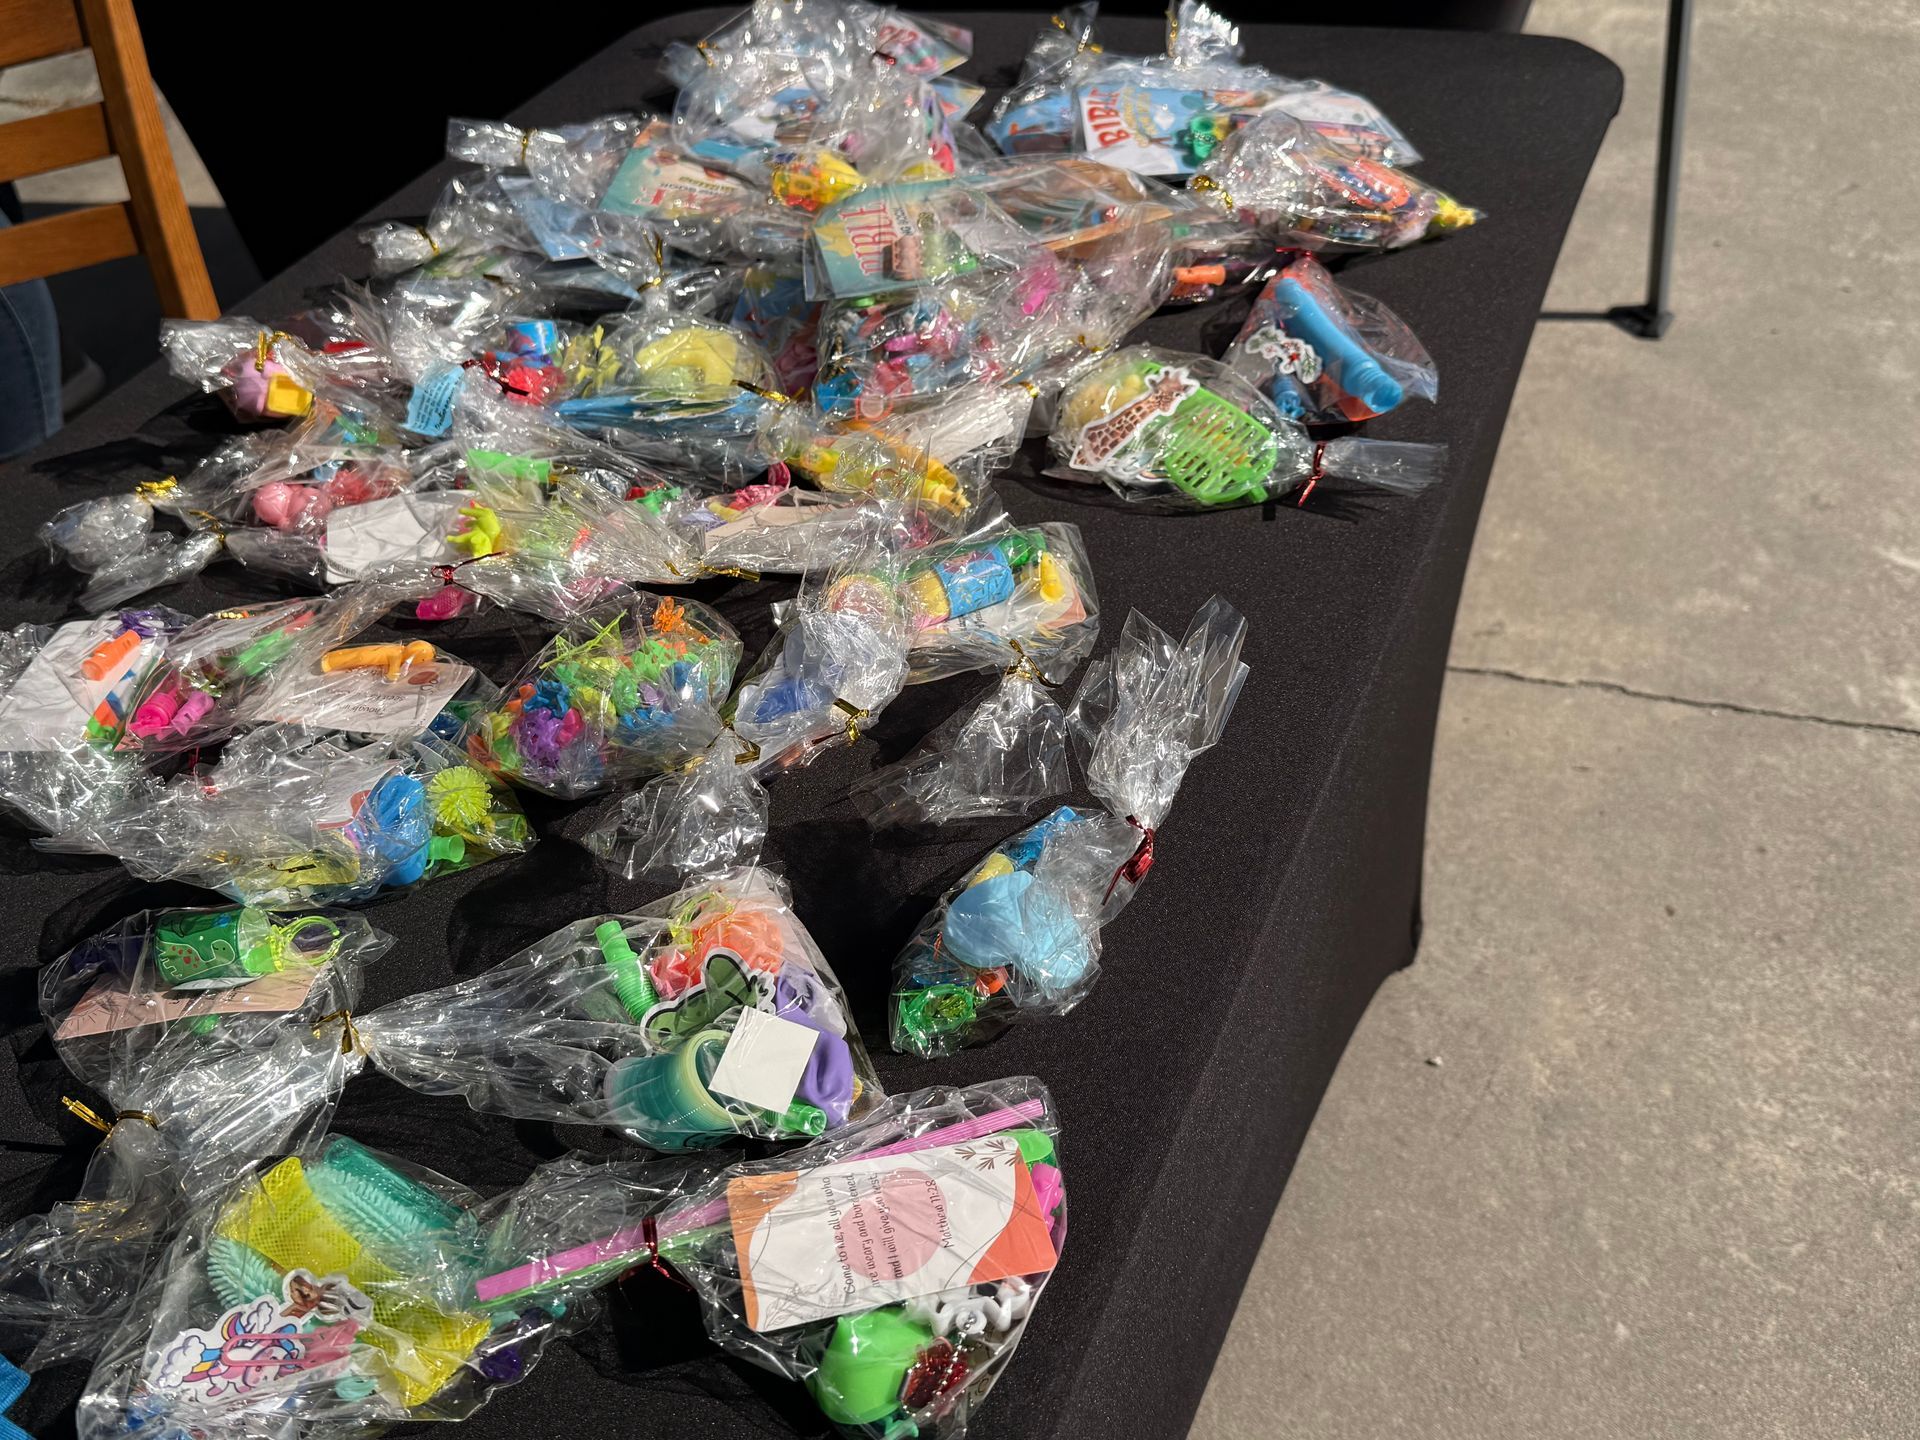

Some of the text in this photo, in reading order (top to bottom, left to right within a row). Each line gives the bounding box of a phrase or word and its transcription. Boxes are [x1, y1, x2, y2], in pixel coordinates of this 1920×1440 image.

[821, 1177, 834, 1197] who
[827, 1199, 841, 1217] you
[875, 1196, 890, 1213] you
[925, 1179, 954, 1248] Matthew 11:28
[827, 1218, 841, 1230] all
[852, 1220, 868, 1237] and
[879, 1214, 895, 1234] give
[881, 1236, 897, 1253] will
[837, 1250, 848, 1262] to
[862, 1238, 876, 1270] weary
[887, 1260, 904, 1279] and
[841, 1264, 856, 1294] Come
[869, 1271, 880, 1287] are
